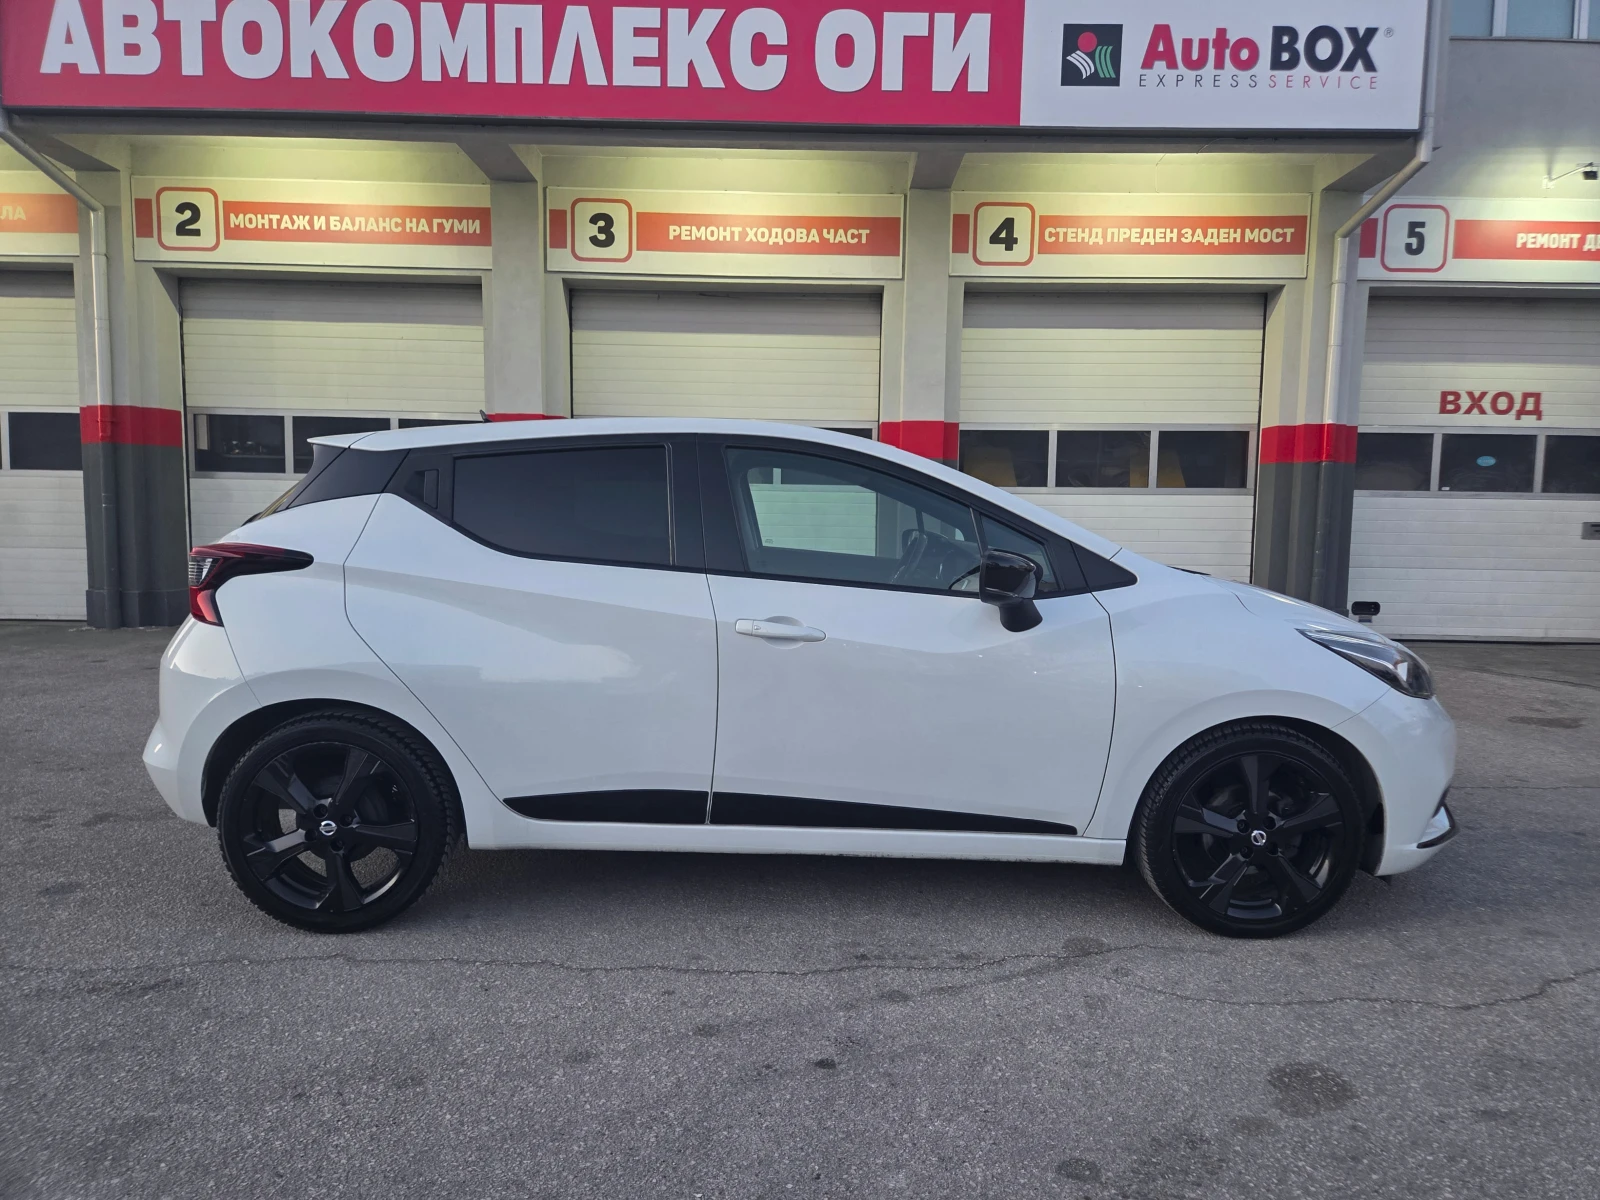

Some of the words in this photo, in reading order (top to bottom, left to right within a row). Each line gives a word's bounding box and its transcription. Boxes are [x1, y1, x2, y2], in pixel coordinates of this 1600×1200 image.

[40, 0, 788, 91] АВТОКОМПЛЕКС
[814, 9, 991, 93] ОГИ
[1140, 23, 1260, 72] Auto
[174, 201, 202, 237] 2
[229, 212, 311, 231] МОНТАЖ
[313, 215, 327, 231] И
[329, 215, 402, 233] БАЛАНС
[405, 217, 430, 233] НА
[432, 218, 480, 235] ГУМИ
[588, 212, 616, 248] 3
[668, 225, 743, 242] РЕМОНТ
[745, 227, 820, 246] ХОДОВА
[822, 228, 870, 244] ЧАСТ
[988, 216, 1019, 252] 4
[1044, 227, 1103, 246] СТЕНД
[1106, 227, 1178, 246] ПРЕДЕН
[1180, 228, 1241, 246] ЗАДЕН
[1244, 228, 1295, 243] МОСТ
[1404, 220, 1427, 257] 5
[1515, 232, 1582, 249] РЕМОНТ
[1438, 390, 1543, 421] ВХОД
